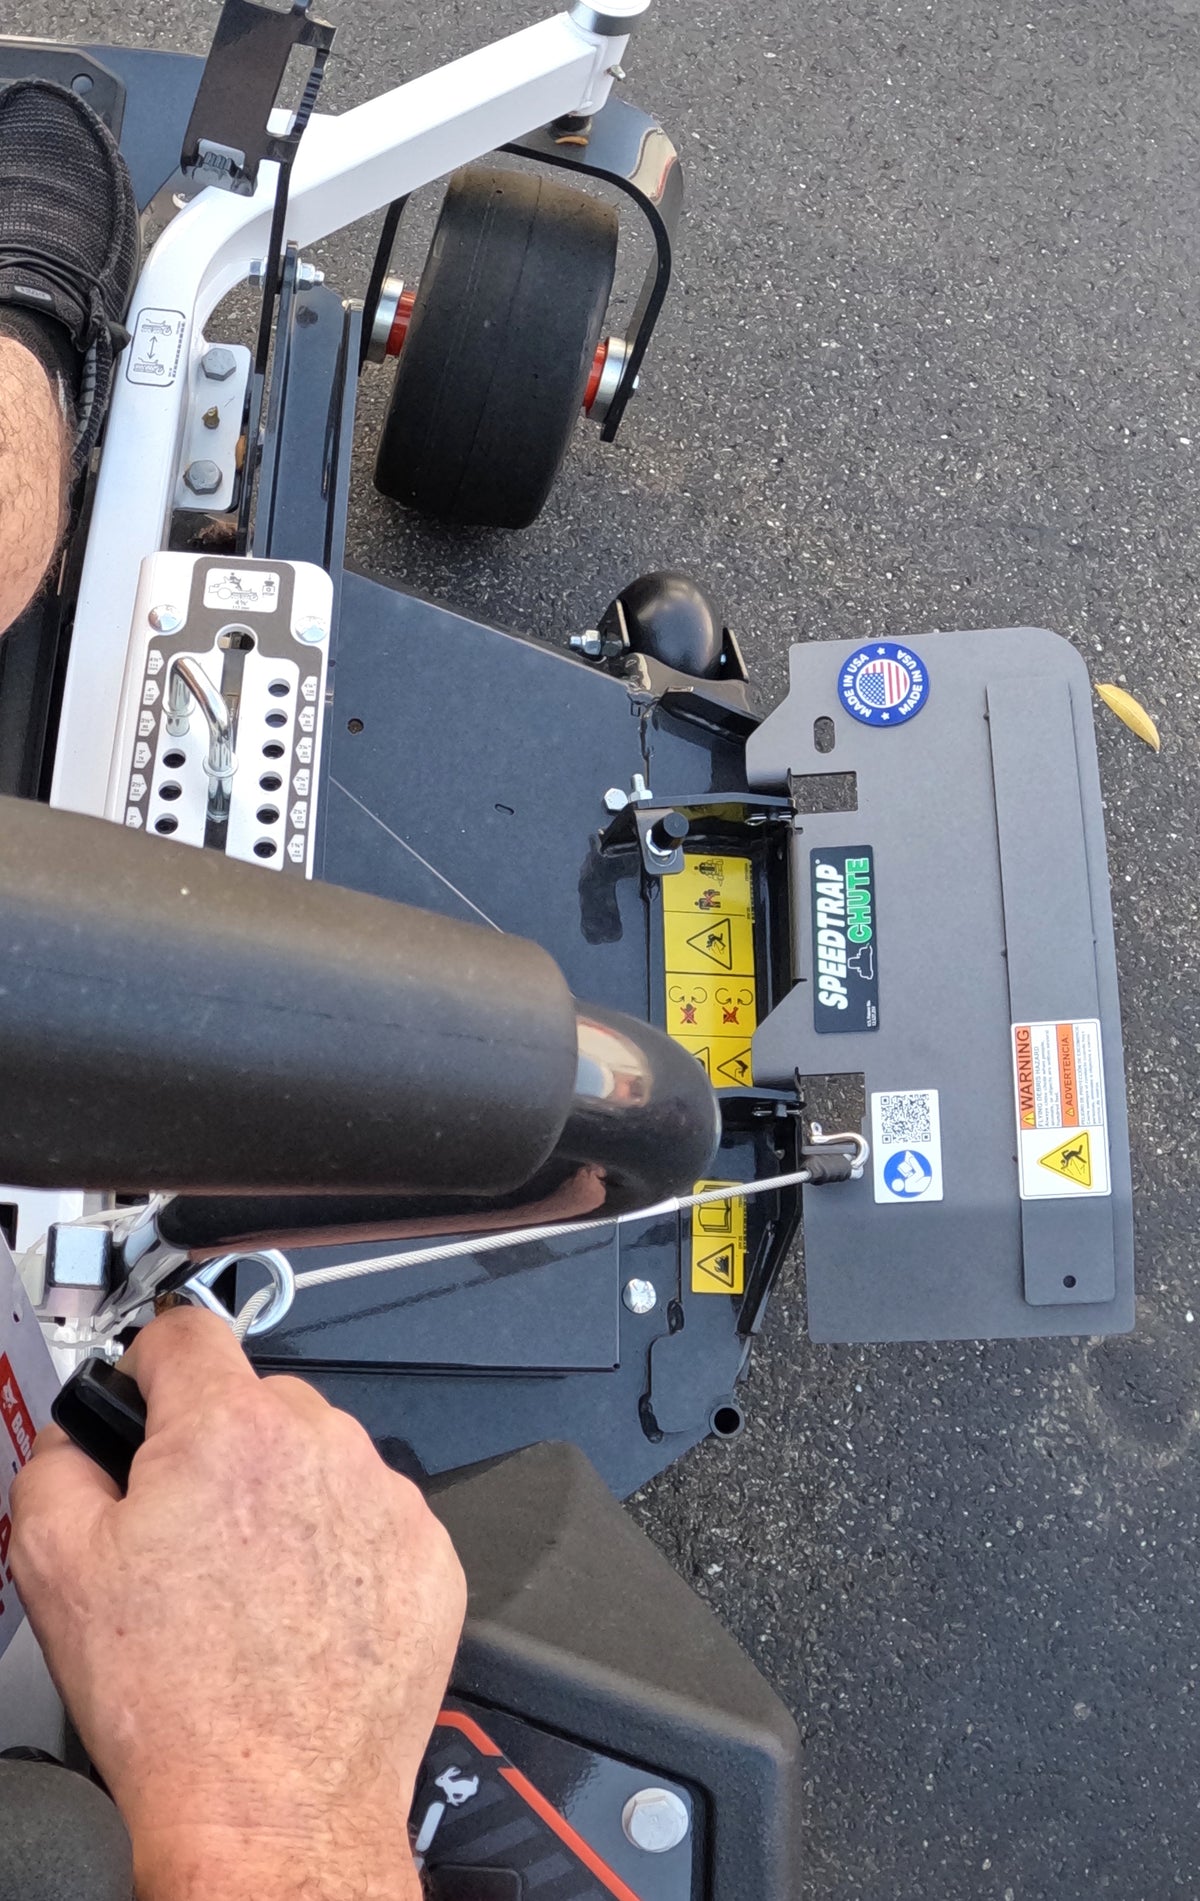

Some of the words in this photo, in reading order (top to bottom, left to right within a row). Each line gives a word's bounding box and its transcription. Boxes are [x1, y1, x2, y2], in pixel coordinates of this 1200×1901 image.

[847, 653, 869, 673] USA
[897, 649, 917, 670] USA
[843, 675, 853, 687] IN
[911, 670, 922, 682] IN
[844, 690, 872, 718] MADE
[898, 684, 923, 715] MADE
[845, 857, 872, 943] CHUTE
[815, 863, 848, 1010] SPEEDTRAP
[1017, 1029, 1034, 1110] WARNING
[1062, 1034, 1074, 1106] ADVERTENCIA:
